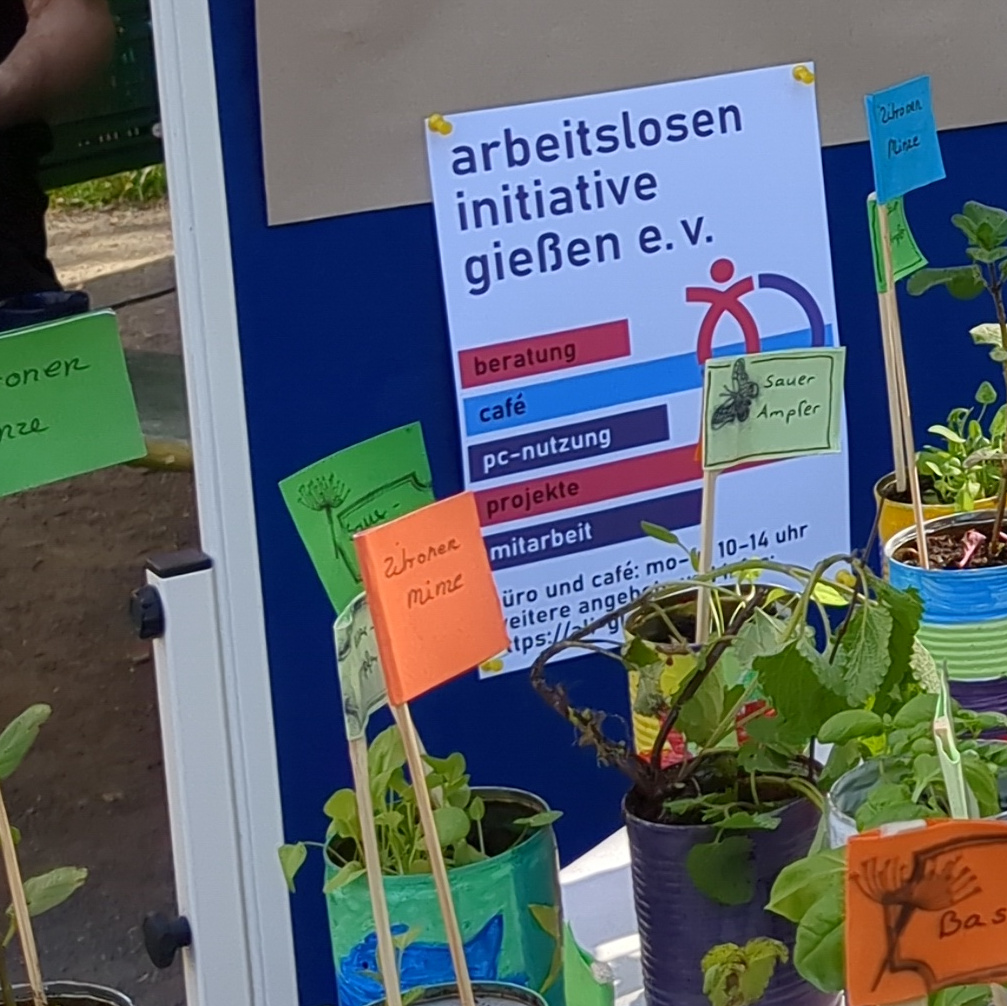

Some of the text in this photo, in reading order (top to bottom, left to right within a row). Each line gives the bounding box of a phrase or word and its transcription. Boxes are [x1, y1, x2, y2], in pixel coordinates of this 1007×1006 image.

[452, 104, 742, 175] arbeitslosen
[457, 170, 658, 231] initiative
[465, 230, 620, 296] gießen
[474, 341, 576, 376] beratung
[763, 374, 816, 388] Sauer
[479, 393, 527, 423] café
[756, 400, 821, 424] Ampfer
[482, 427, 611, 473] pc-nutzung
[486, 482, 579, 519] projekte
[491, 523, 593, 562] mitarbeit
[502, 588, 538, 608] üro
[546, 574, 584, 598] und
[592, 560, 640, 587] café:
[718, 530, 768, 557] 10-14
[776, 524, 808, 544] uhr
[504, 604, 571, 629] eitere
